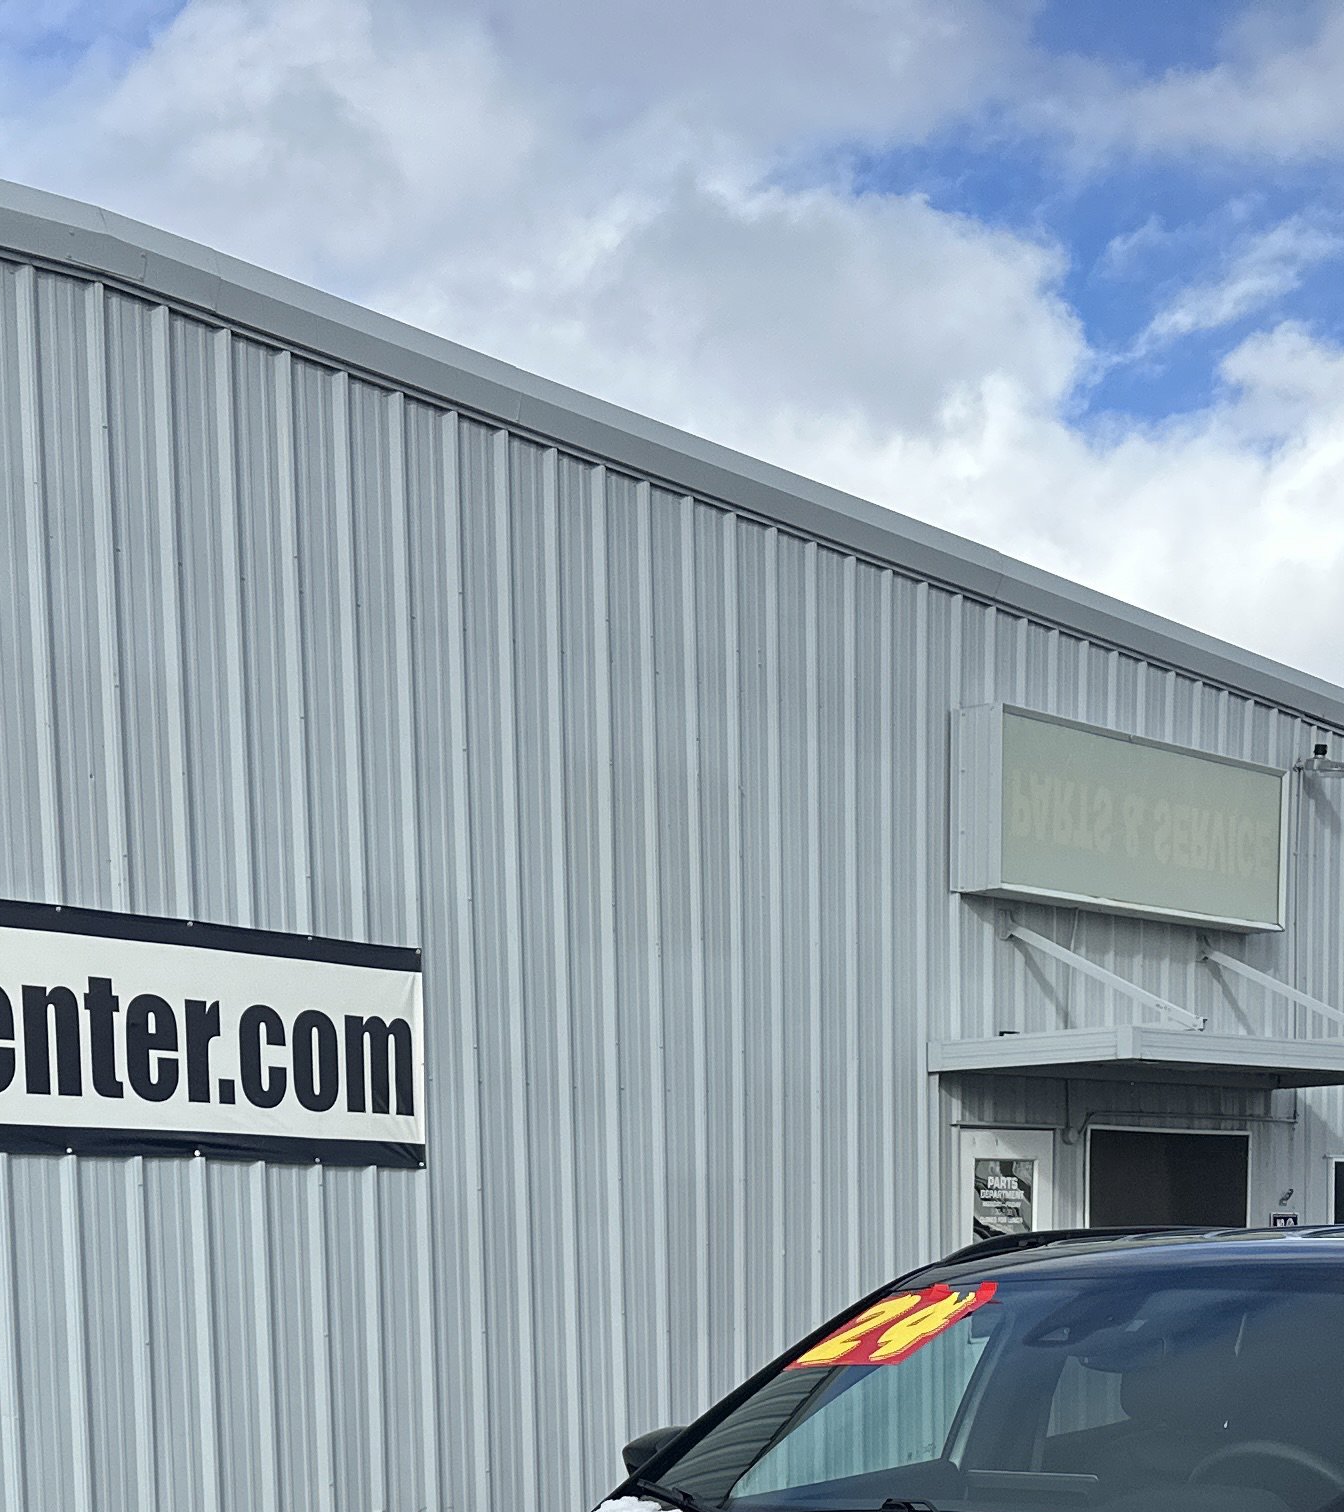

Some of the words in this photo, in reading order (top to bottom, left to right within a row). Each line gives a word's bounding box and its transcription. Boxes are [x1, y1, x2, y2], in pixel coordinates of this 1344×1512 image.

[987, 1176, 1018, 1190] PARTS
[980, 1190, 1025, 1200] DEPARTMENT
[796, 1291, 977, 1363] 24
